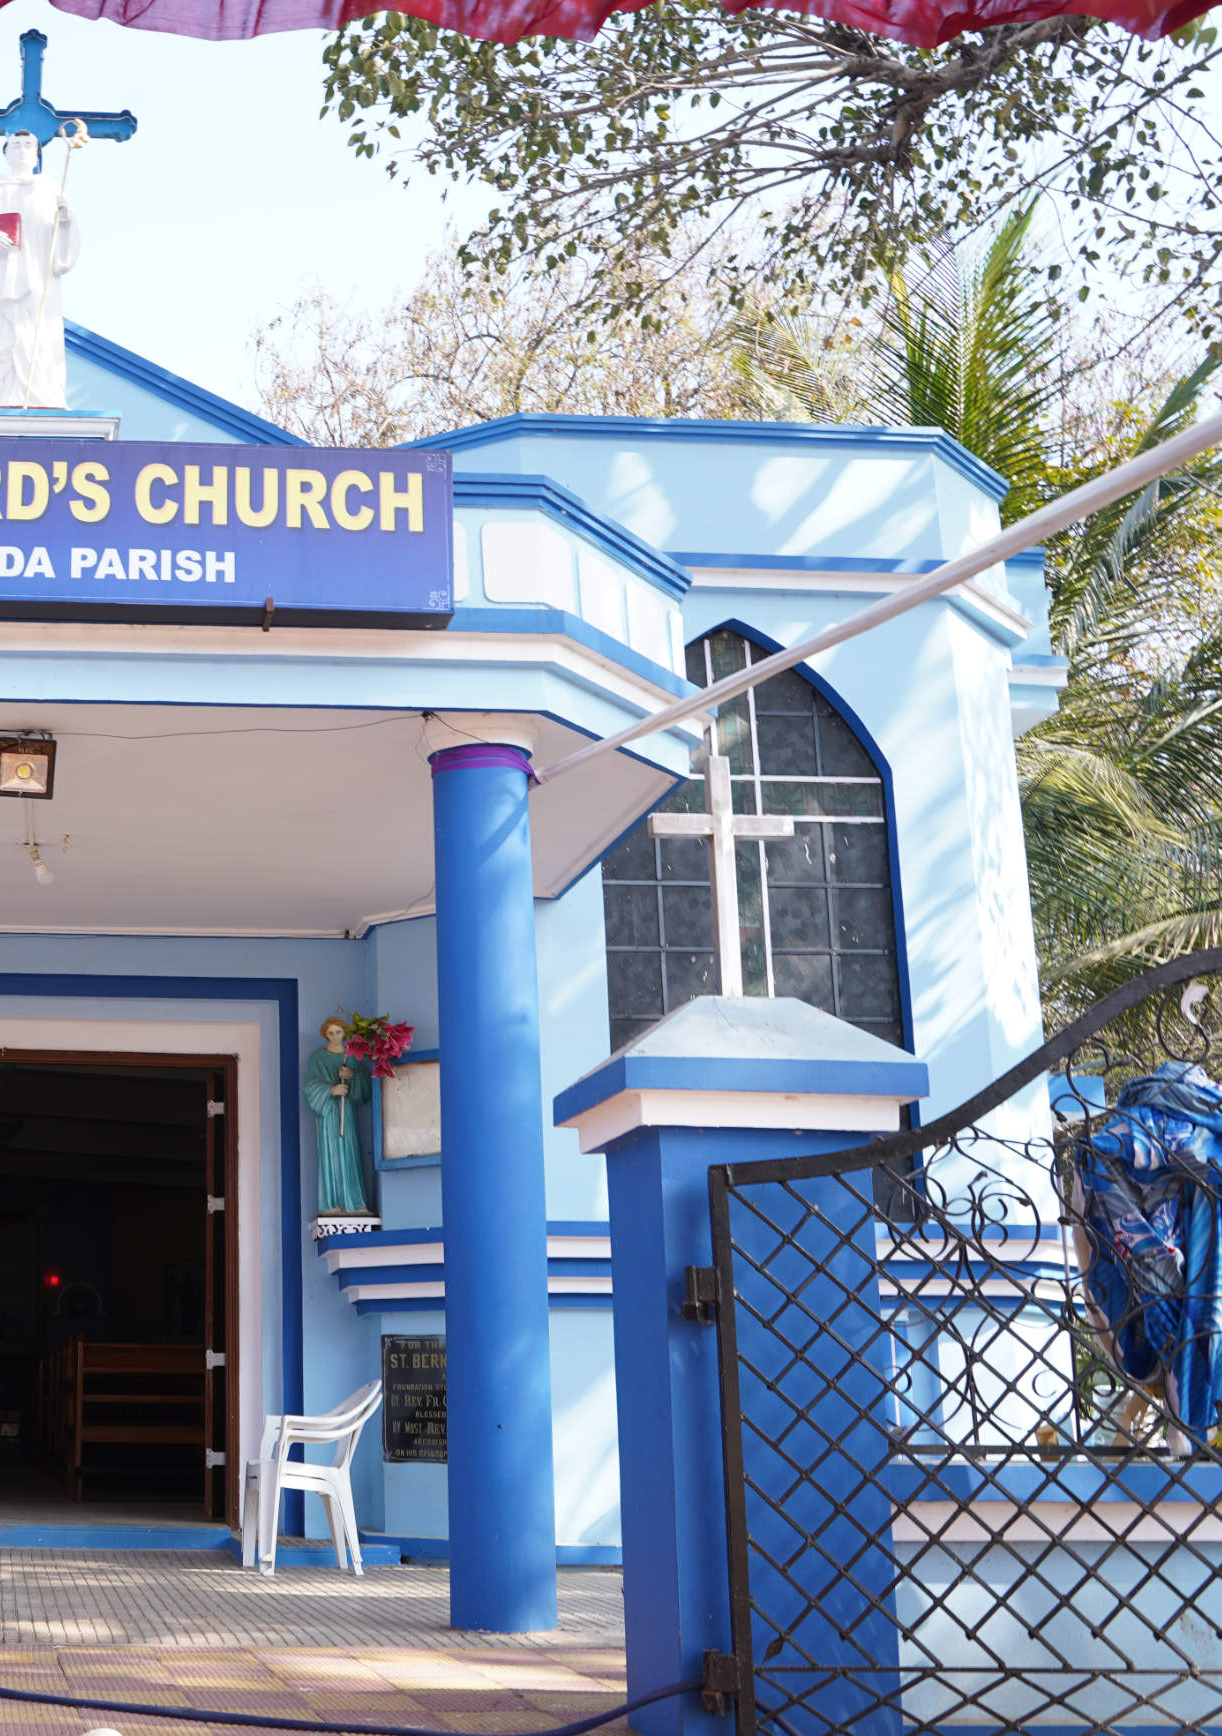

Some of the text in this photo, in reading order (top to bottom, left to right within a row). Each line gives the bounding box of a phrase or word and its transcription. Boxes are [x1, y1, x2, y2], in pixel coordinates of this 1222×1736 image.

[134, 463, 424, 533] CHURCH
[70, 547, 236, 584] PARISH
[390, 1353, 409, 1369] ST.
